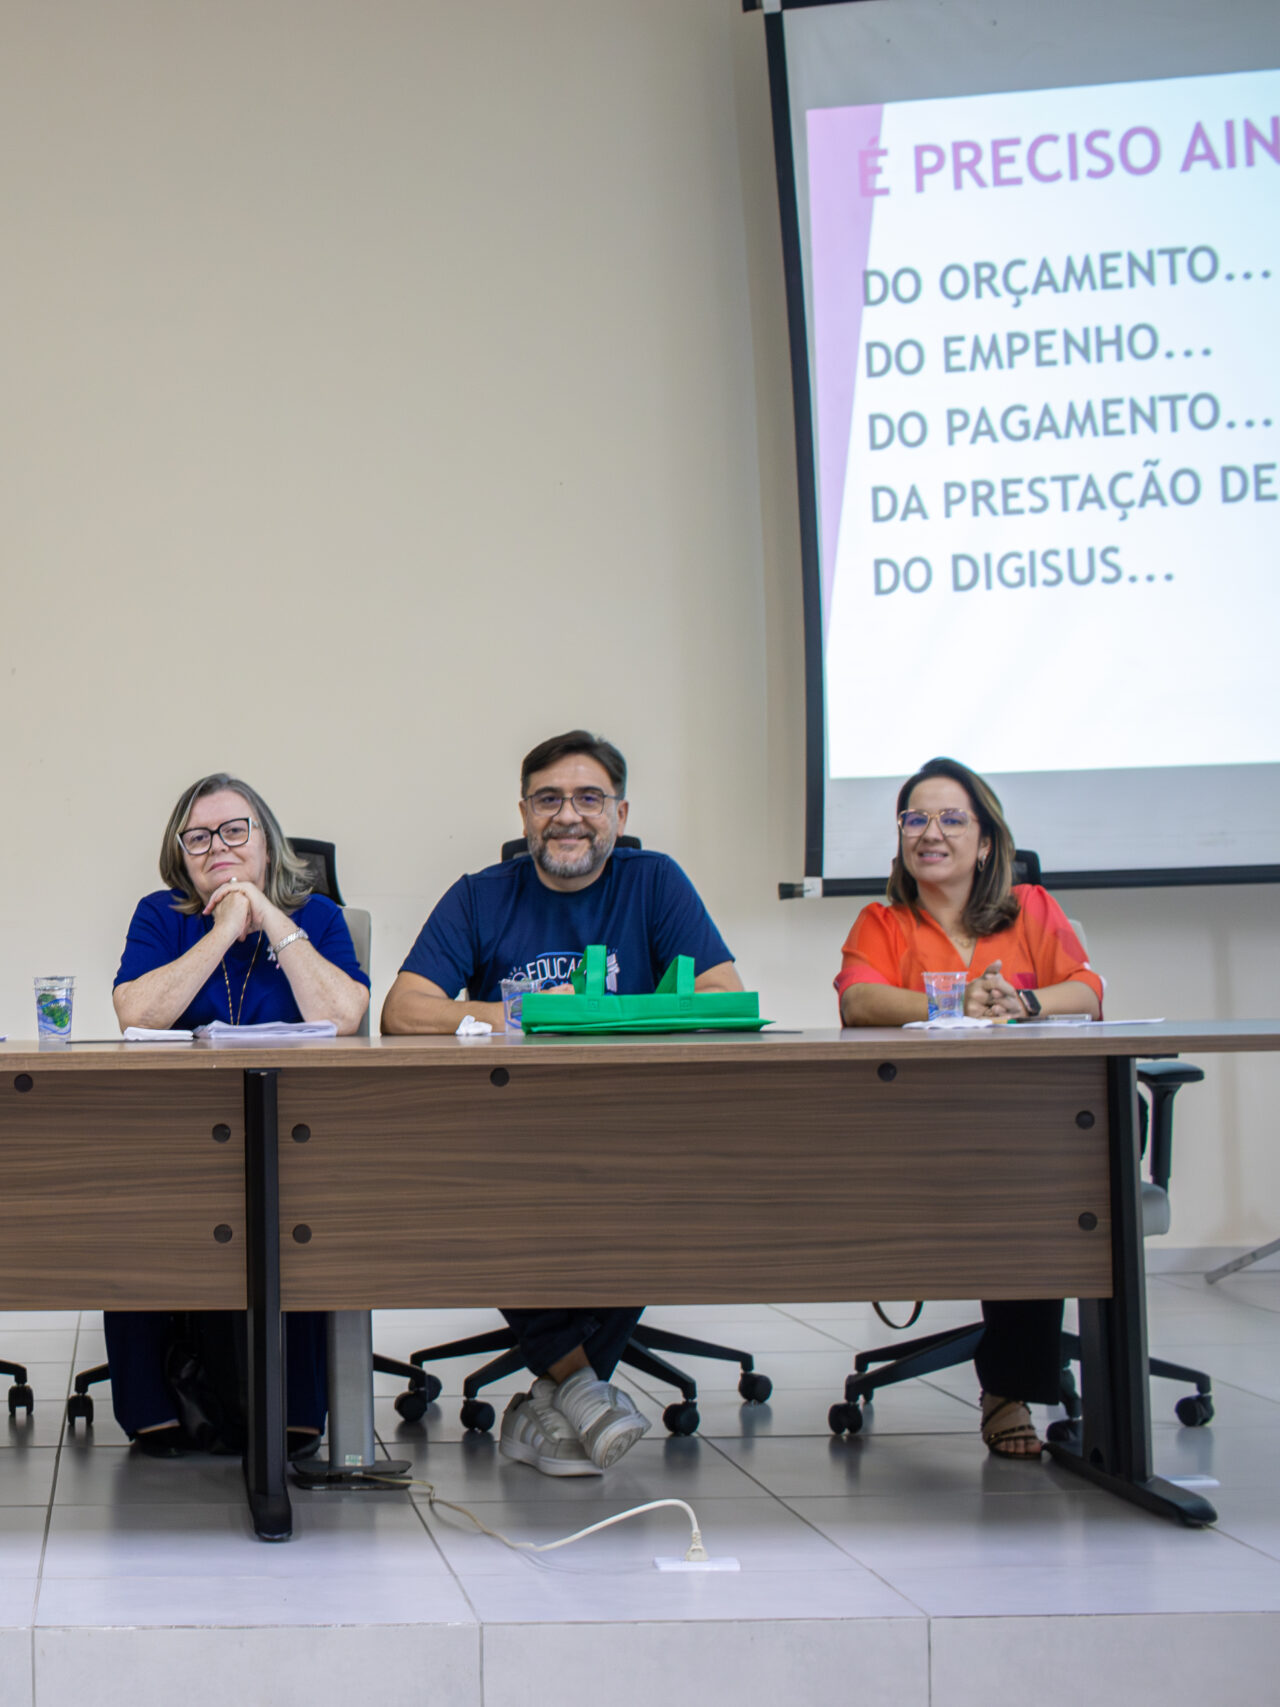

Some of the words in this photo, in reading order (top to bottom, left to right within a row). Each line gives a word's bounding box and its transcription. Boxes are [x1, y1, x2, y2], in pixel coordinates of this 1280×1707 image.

[858, 136, 890, 197] É
[914, 126, 1161, 194] PRECISO
[1180, 115, 1280, 173] AIN
[862, 268, 922, 307] DO
[939, 245, 1271, 308] ORÇAMENTO...
[866, 339, 924, 378] DO
[943, 323, 1212, 373] EMPENHO...
[869, 411, 928, 451] DO
[946, 392, 1272, 446] PAGAMENTO...
[871, 484, 929, 523] DA
[943, 459, 1201, 521] PRESTAÇÃO
[1221, 463, 1278, 504] DE
[874, 556, 932, 596] DO
[952, 546, 1174, 592] DIGISUS...
